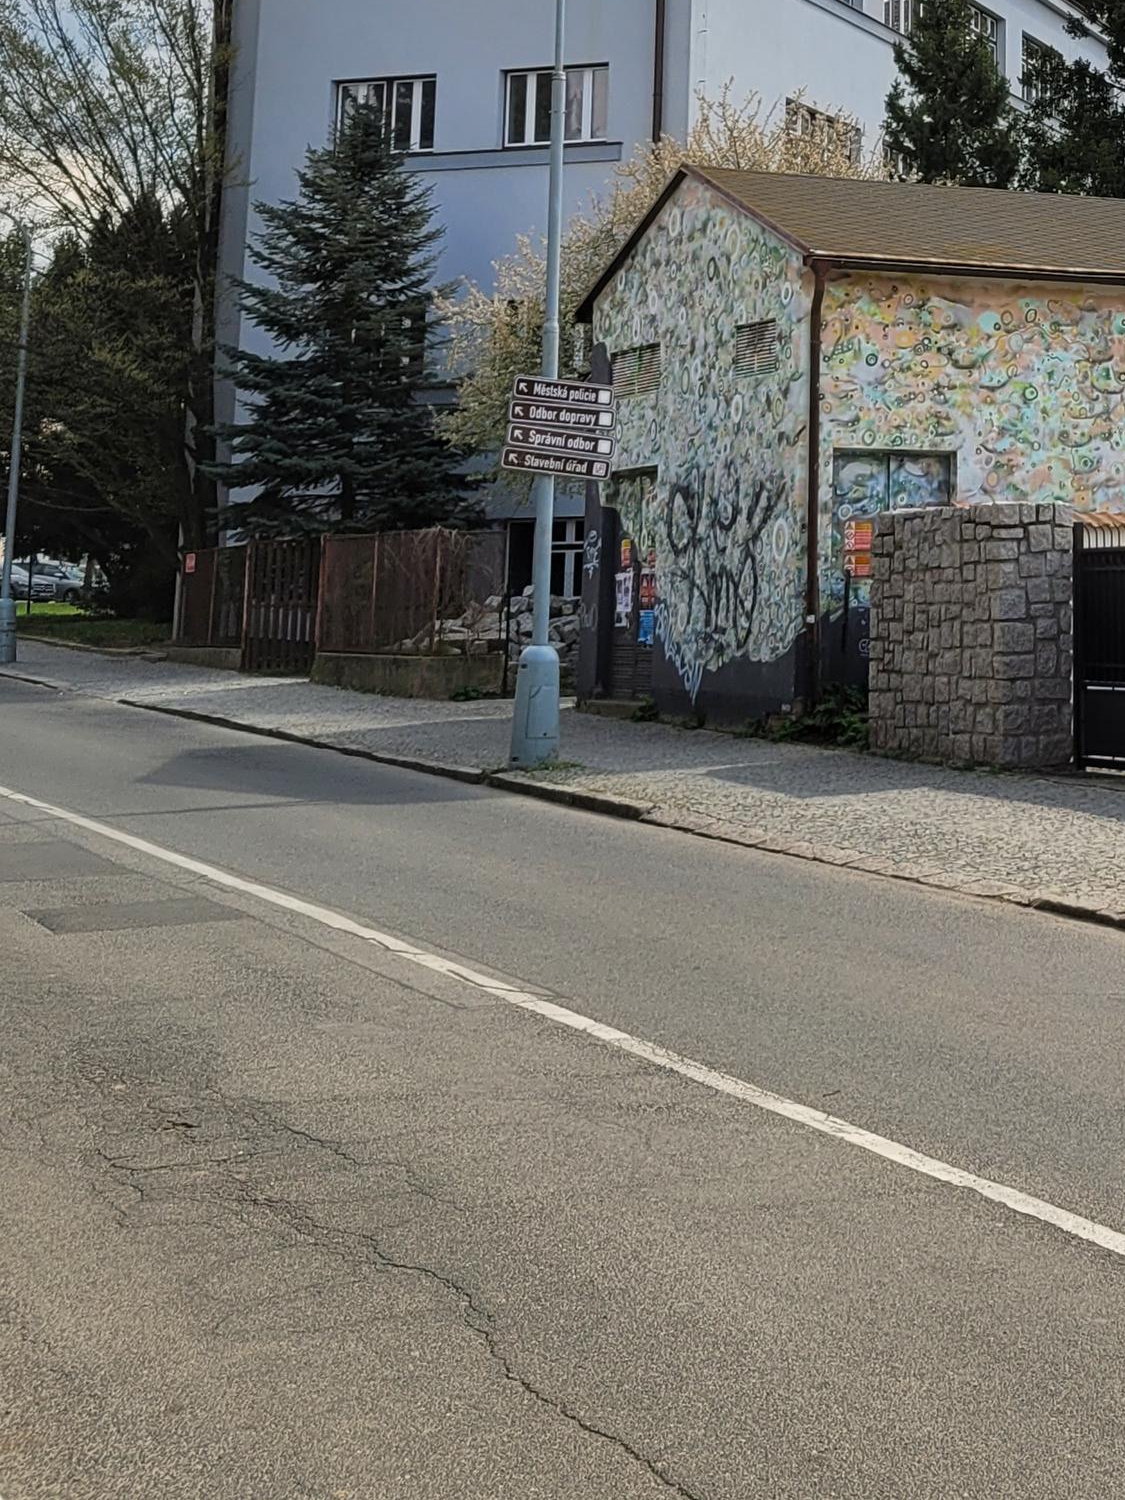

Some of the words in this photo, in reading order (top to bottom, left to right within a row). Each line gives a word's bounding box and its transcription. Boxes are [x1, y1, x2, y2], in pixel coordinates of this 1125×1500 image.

[569, 388, 597, 402] policie
[529, 406, 557, 419] Odbor
[560, 409, 597, 426] dopravy
[528, 430, 566, 446] Správní
[567, 436, 595, 450] odbor
[524, 454, 566, 470] Stavební
[566, 458, 588, 473] úřad
